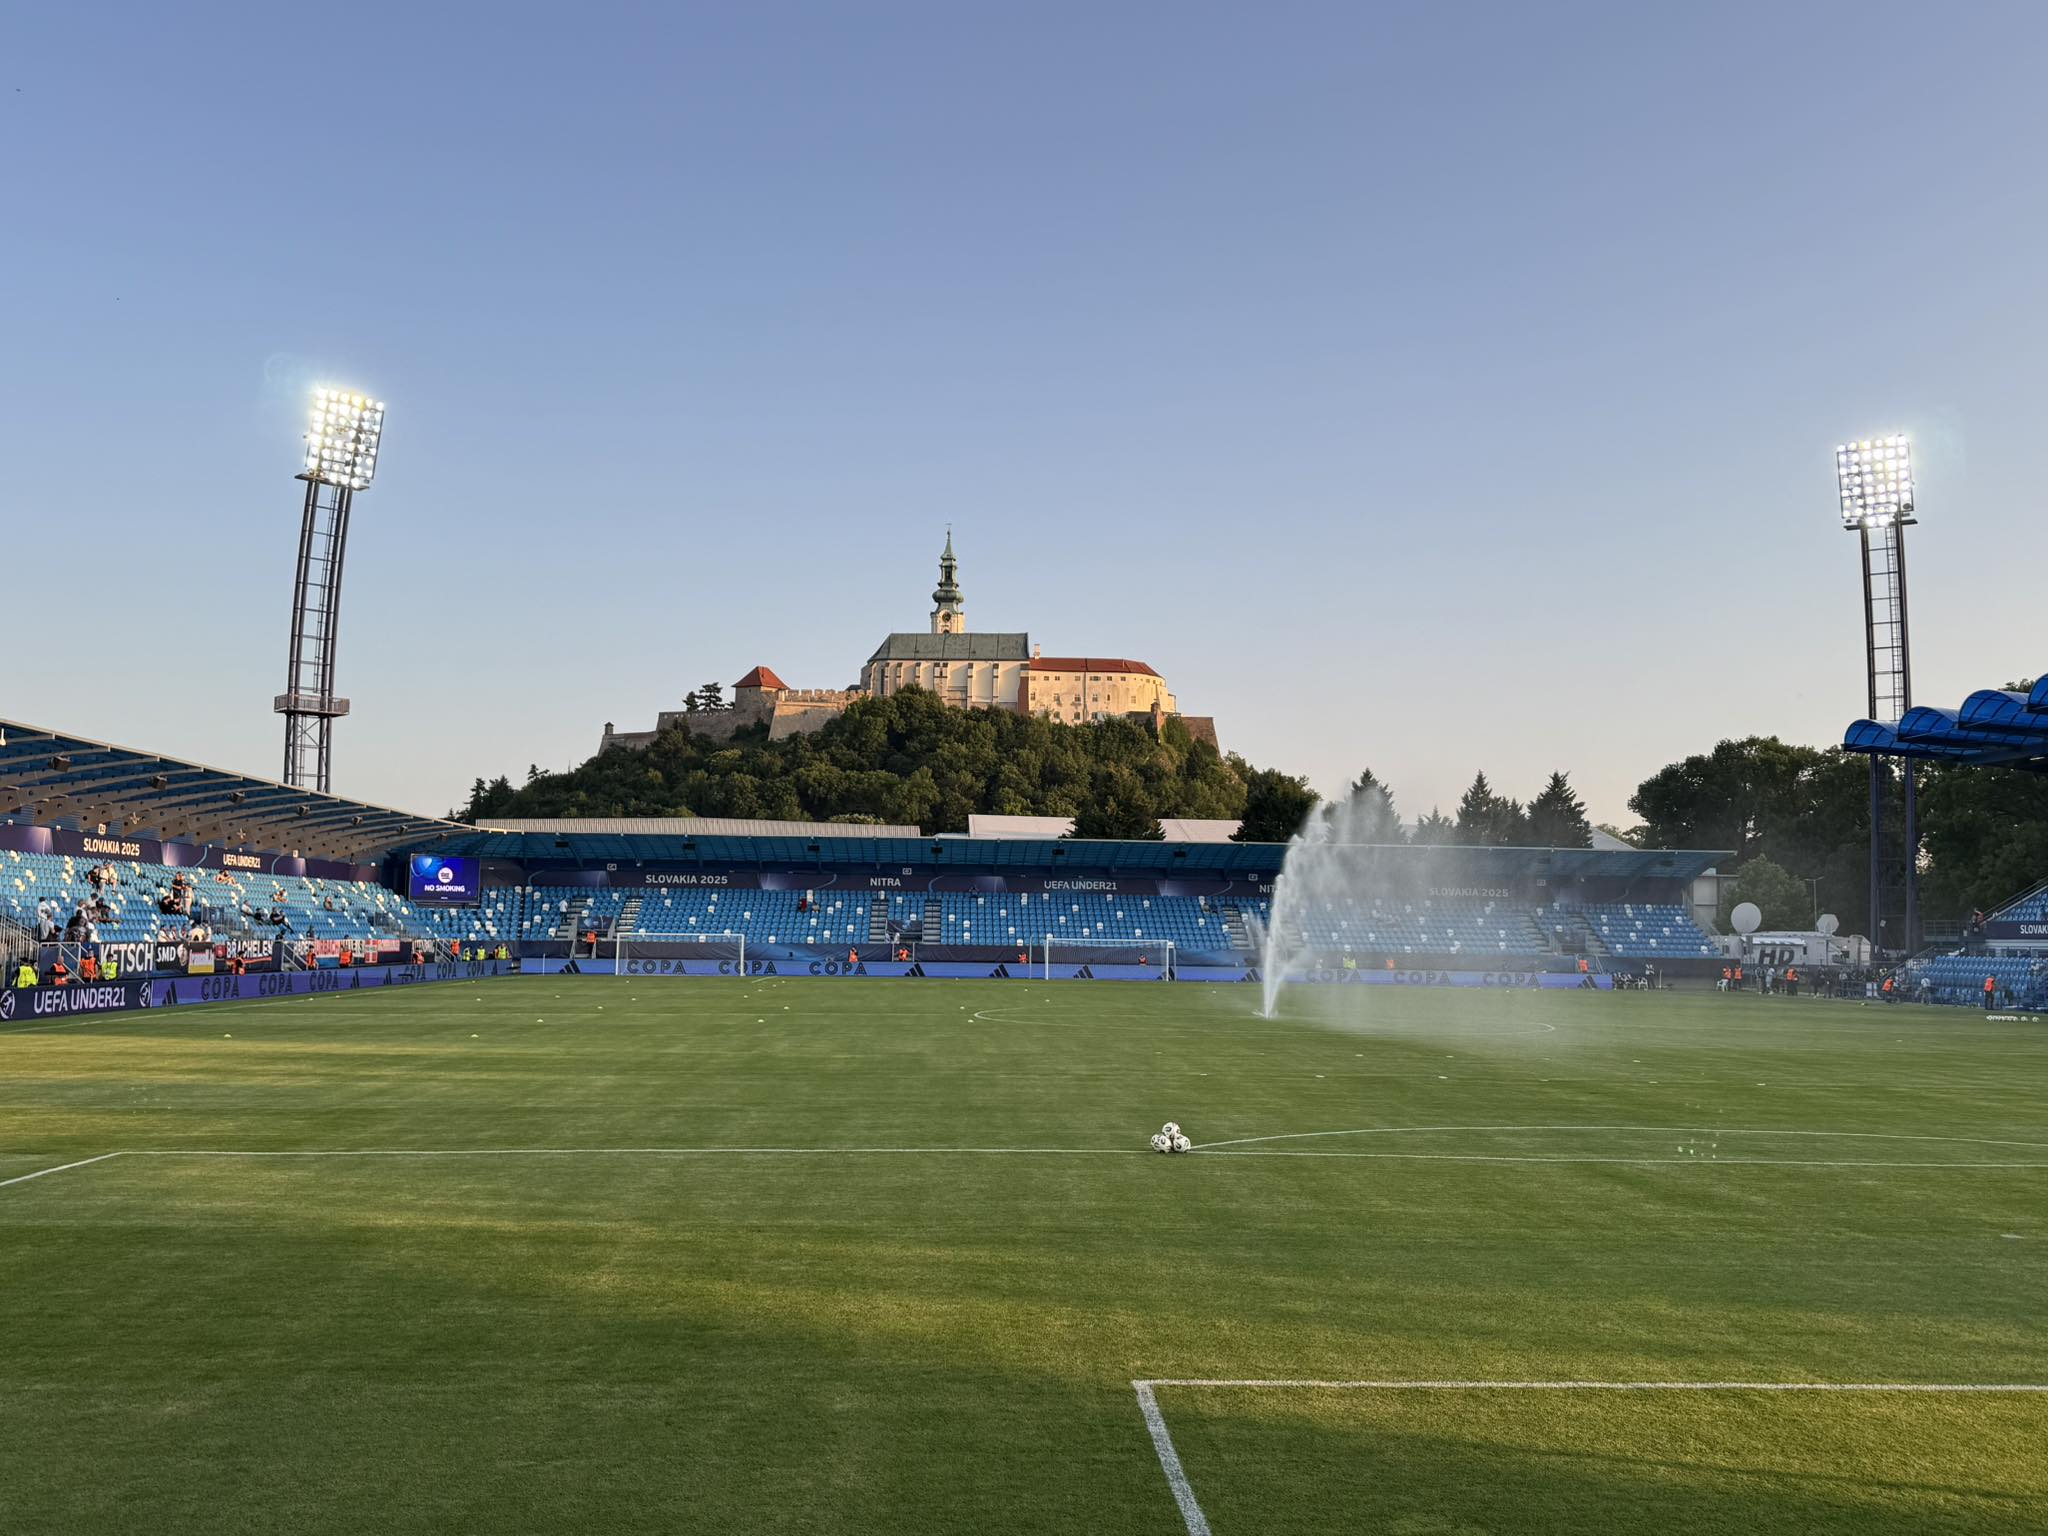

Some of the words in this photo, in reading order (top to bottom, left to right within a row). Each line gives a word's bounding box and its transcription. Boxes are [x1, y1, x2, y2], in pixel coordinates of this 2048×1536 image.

[83, 838, 120, 855] SLOVAKIA
[121, 842, 140, 857] 2025
[645, 874, 698, 885] SLOVAKIA
[700, 875, 728, 885] 2025
[870, 877, 901, 888] NITRA
[1044, 880, 1070, 890] UEFA
[1071, 881, 1117, 891] UNDER21
[424, 884, 435, 892] NO
[435, 884, 465, 893] SMOKING
[1428, 887, 1479, 898] SLOVAKIA
[1480, 888, 1509, 898] 2025
[156, 945, 177, 963] SMD
[1759, 949, 1795, 966] HD
[626, 959, 687, 975] COPA
[808, 961, 868, 976] COPA
[258, 973, 293, 996] COPA
[309, 970, 339, 992] COPA
[1393, 971, 1451, 985] COPA
[1482, 972, 1541, 988] COPA
[201, 976, 241, 1001] COPA
[33, 990, 69, 1015] UEFA
[71, 987, 126, 1010] UNDER21
